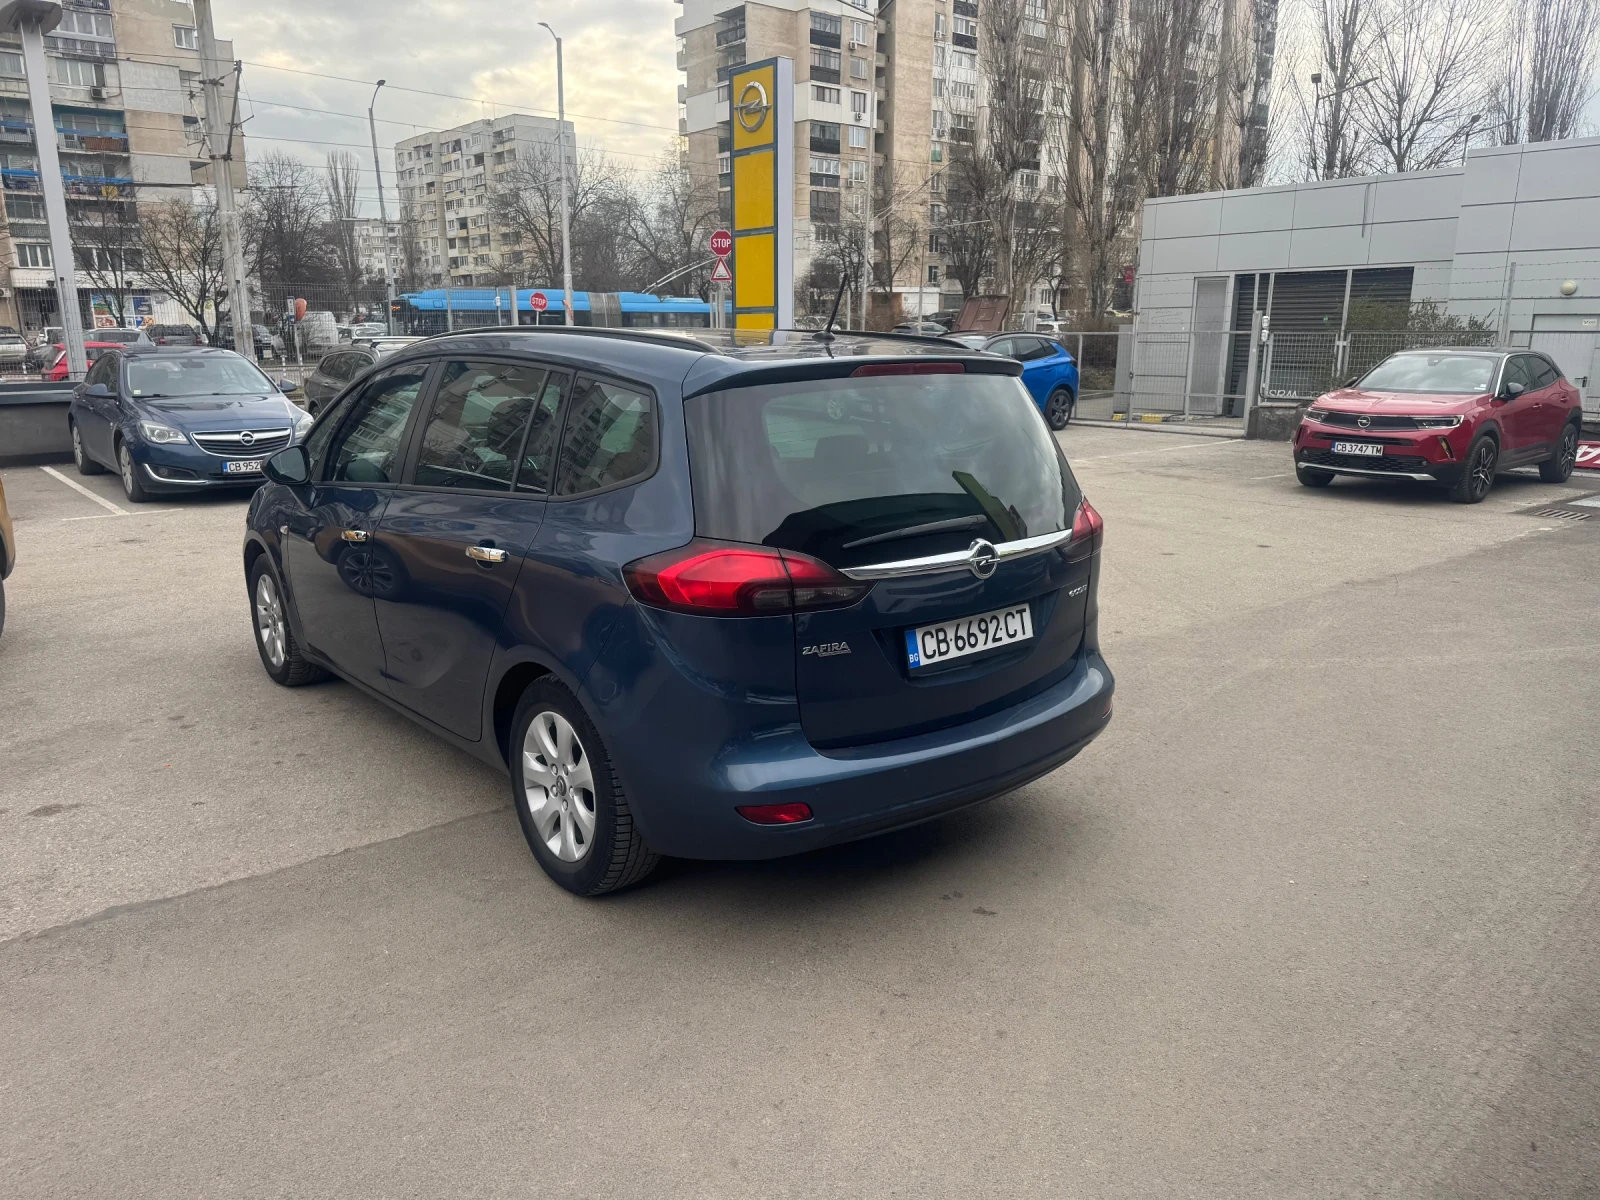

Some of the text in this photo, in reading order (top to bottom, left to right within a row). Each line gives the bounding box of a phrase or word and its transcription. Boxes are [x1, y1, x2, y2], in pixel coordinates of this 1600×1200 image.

[712, 238, 732, 248] STOP
[531, 297, 547, 306] STOP
[1335, 443, 1382, 454] CB 3747 TM
[228, 462, 242, 472] CB
[802, 641, 850, 655] ZAFIRA
[909, 653, 919, 663] BG
